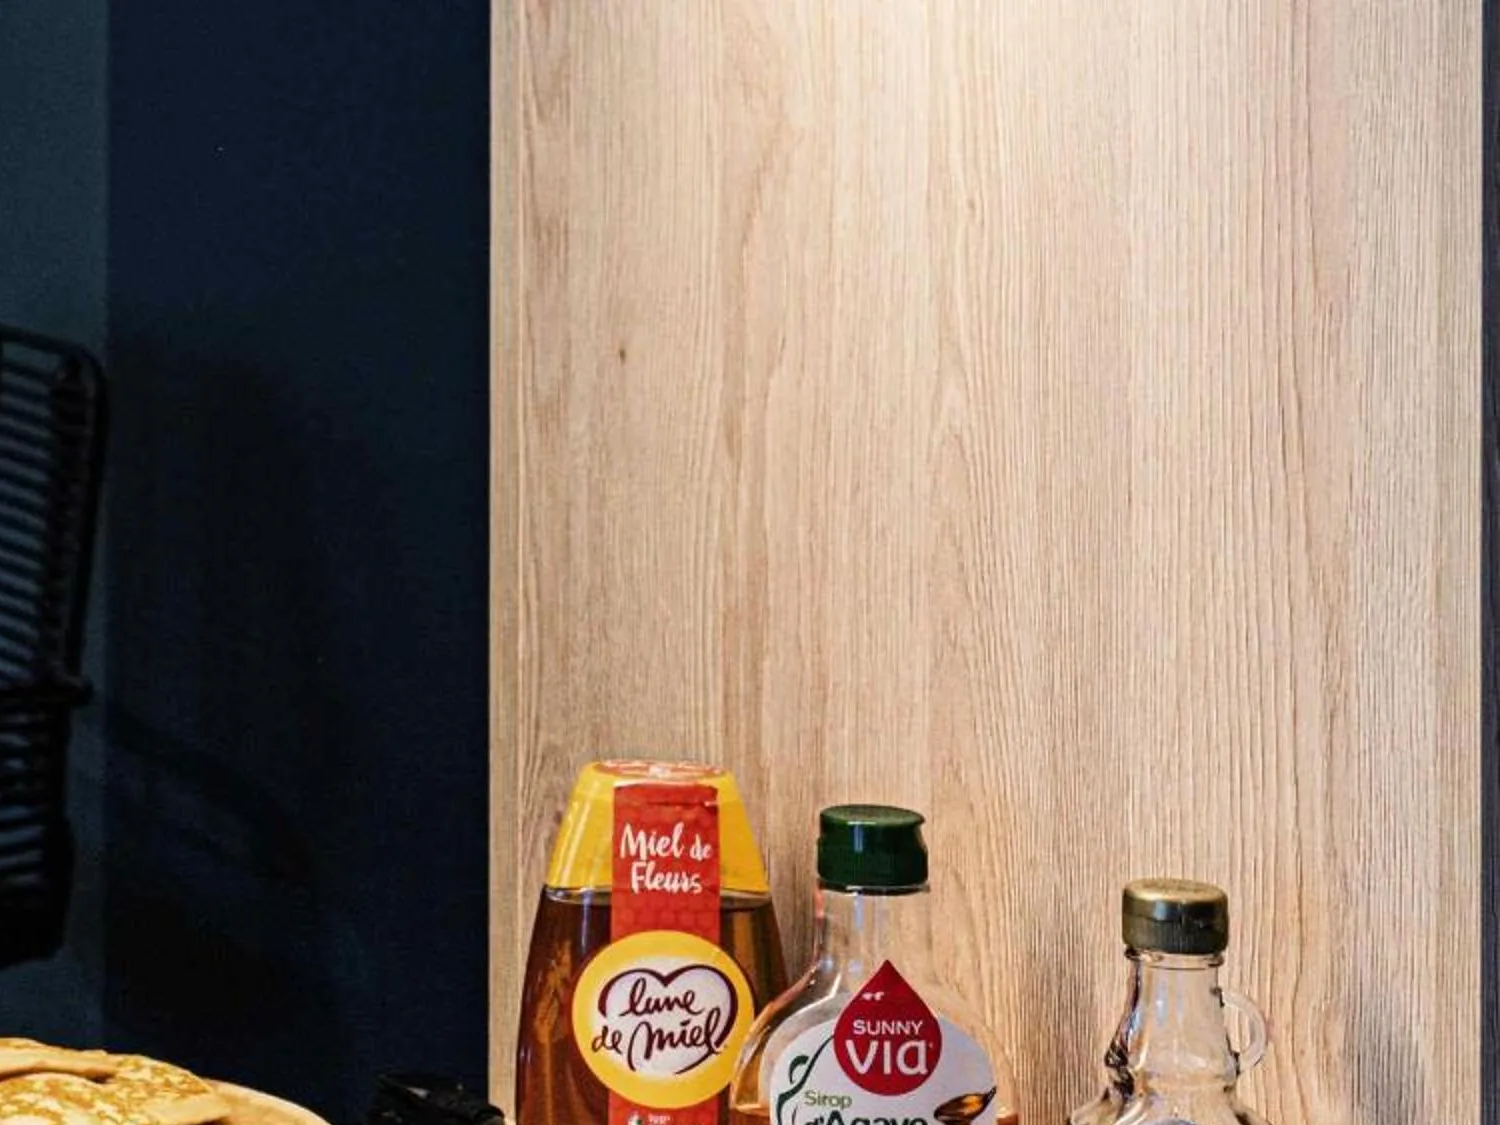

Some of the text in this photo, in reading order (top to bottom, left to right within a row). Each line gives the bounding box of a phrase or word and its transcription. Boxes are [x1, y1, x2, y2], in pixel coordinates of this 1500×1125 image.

[620, 821, 712, 861] Miel de
[631, 860, 703, 894] Fleurs
[619, 977, 705, 1017] lune
[592, 1006, 722, 1072] de miel
[852, 1019, 923, 1035] SUNNY
[804, 1090, 852, 1109] Sirop
